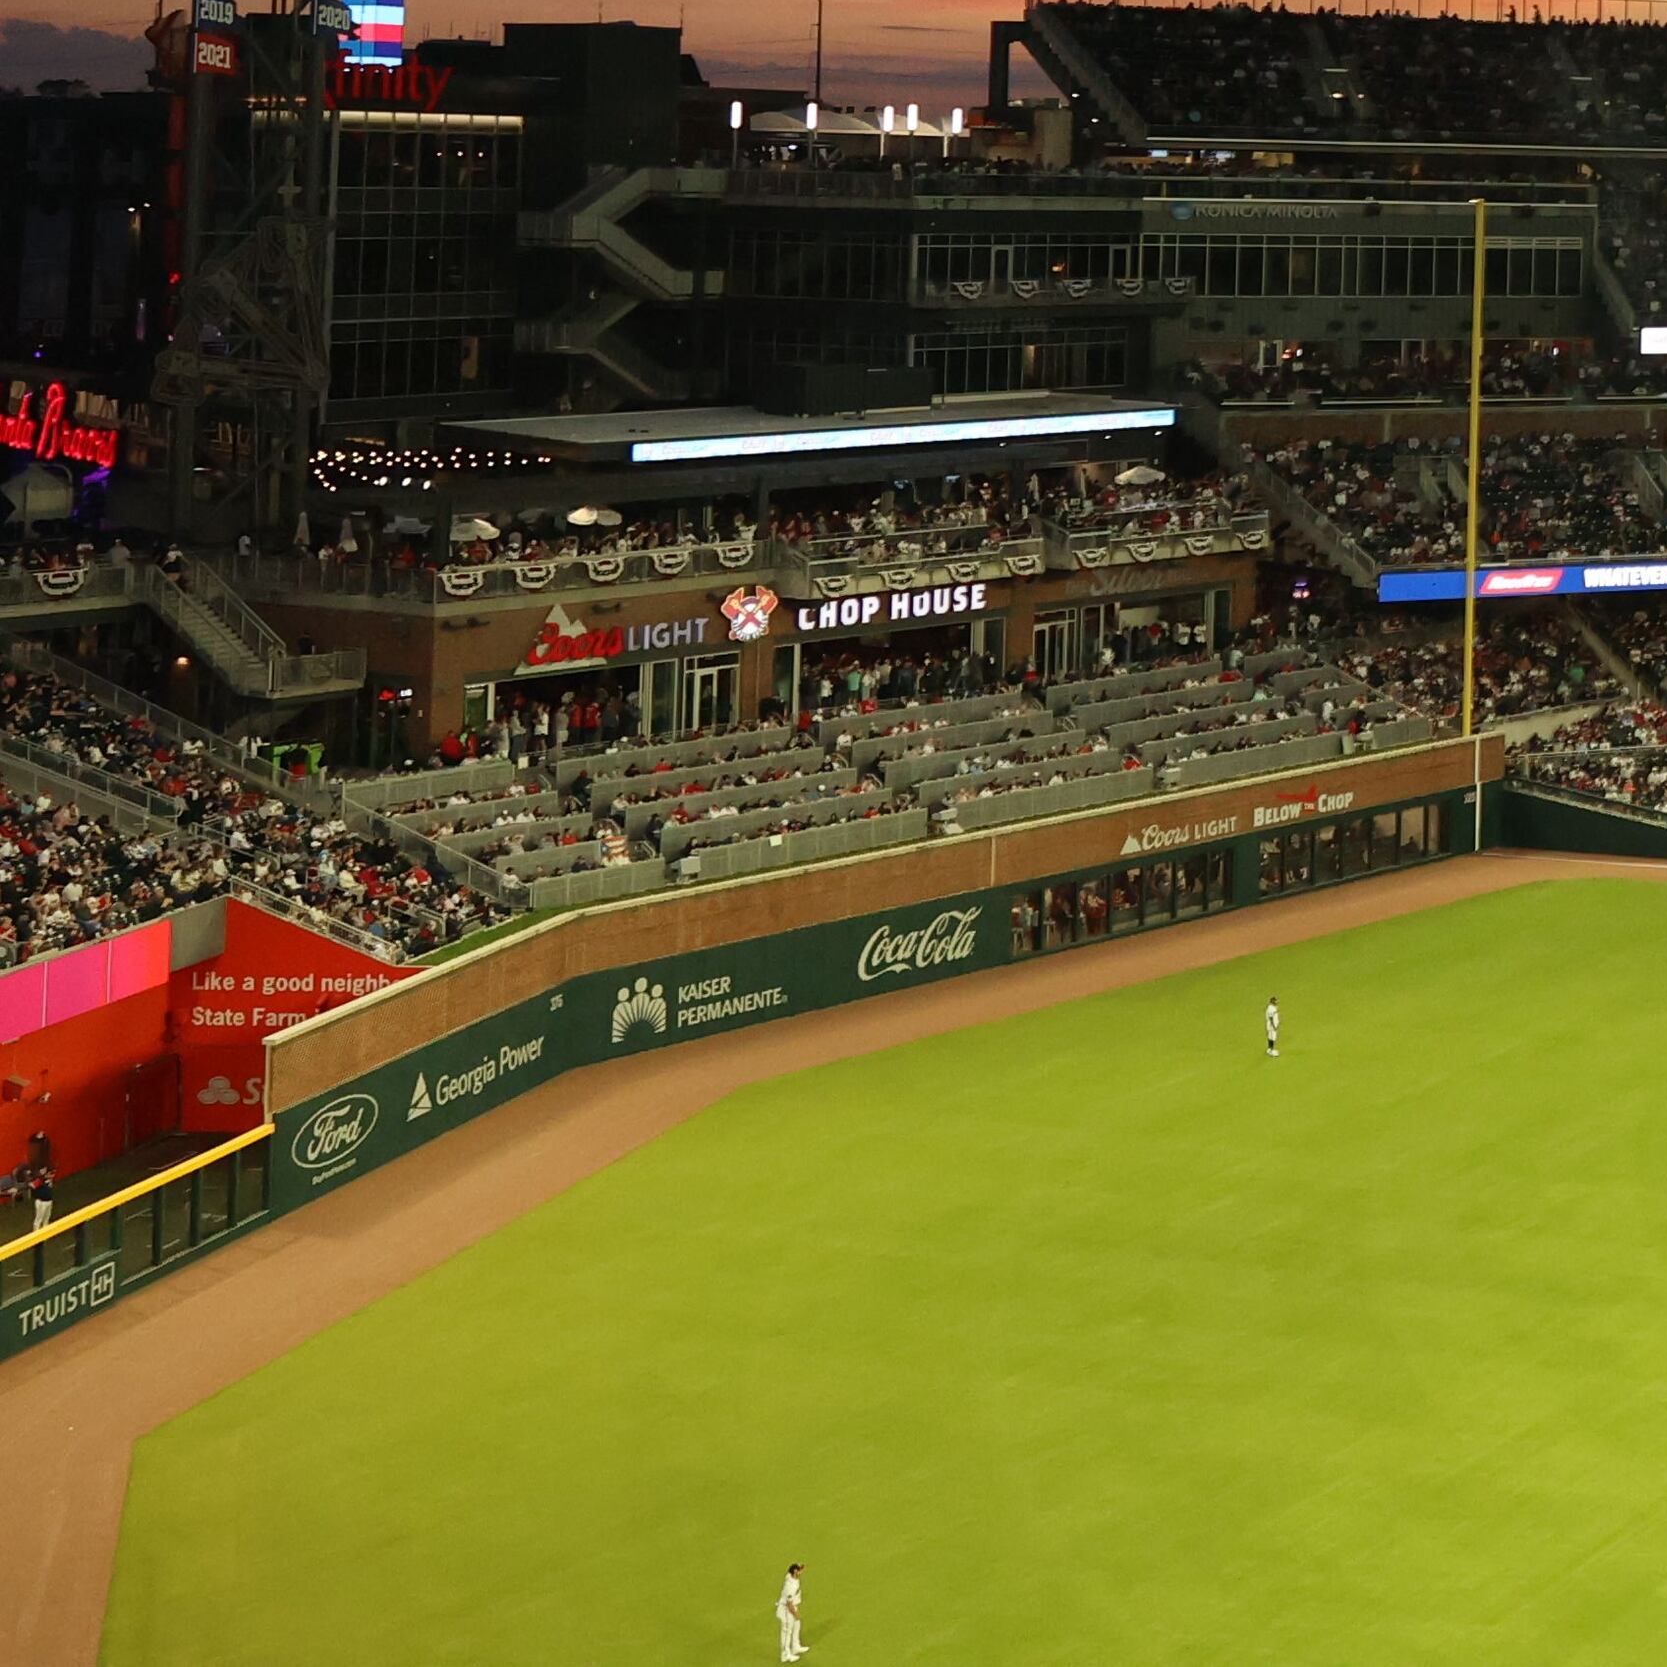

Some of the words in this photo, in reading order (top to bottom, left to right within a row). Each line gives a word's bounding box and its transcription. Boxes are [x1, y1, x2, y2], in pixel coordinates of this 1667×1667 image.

[318, 3, 351, 30] 2020
[198, 42, 232, 69] 2021
[1195, 204, 1261, 219] KONICA
[1267, 205, 1338, 220] MINOLTA
[797, 596, 881, 631] CHOP
[890, 583, 988, 621] HOUSE
[528, 622, 626, 666] Coors
[626, 617, 711, 652] LIGHT
[1253, 801, 1303, 827] BELOW
[1303, 802, 1316, 811] THE
[1318, 791, 1355, 813] CHOP
[1141, 823, 1189, 851] Coors
[1193, 815, 1238, 840] LIGHT
[857, 906, 983, 982] Coca-Cola
[192, 971, 235, 991] Like
[242, 976, 255, 991] a
[262, 974, 314, 995] good
[320, 973, 401, 995] neighb
[678, 975, 732, 1005] KAISER
[192, 1007, 246, 1027] State
[252, 1008, 306, 1027] Farm
[677, 986, 783, 1029] PERMANENTE
[435, 1055, 497, 1108] Georgia
[499, 1035, 546, 1077] Power
[307, 1104, 366, 1162] Ford
[18, 1279, 90, 1337] TRUIST
